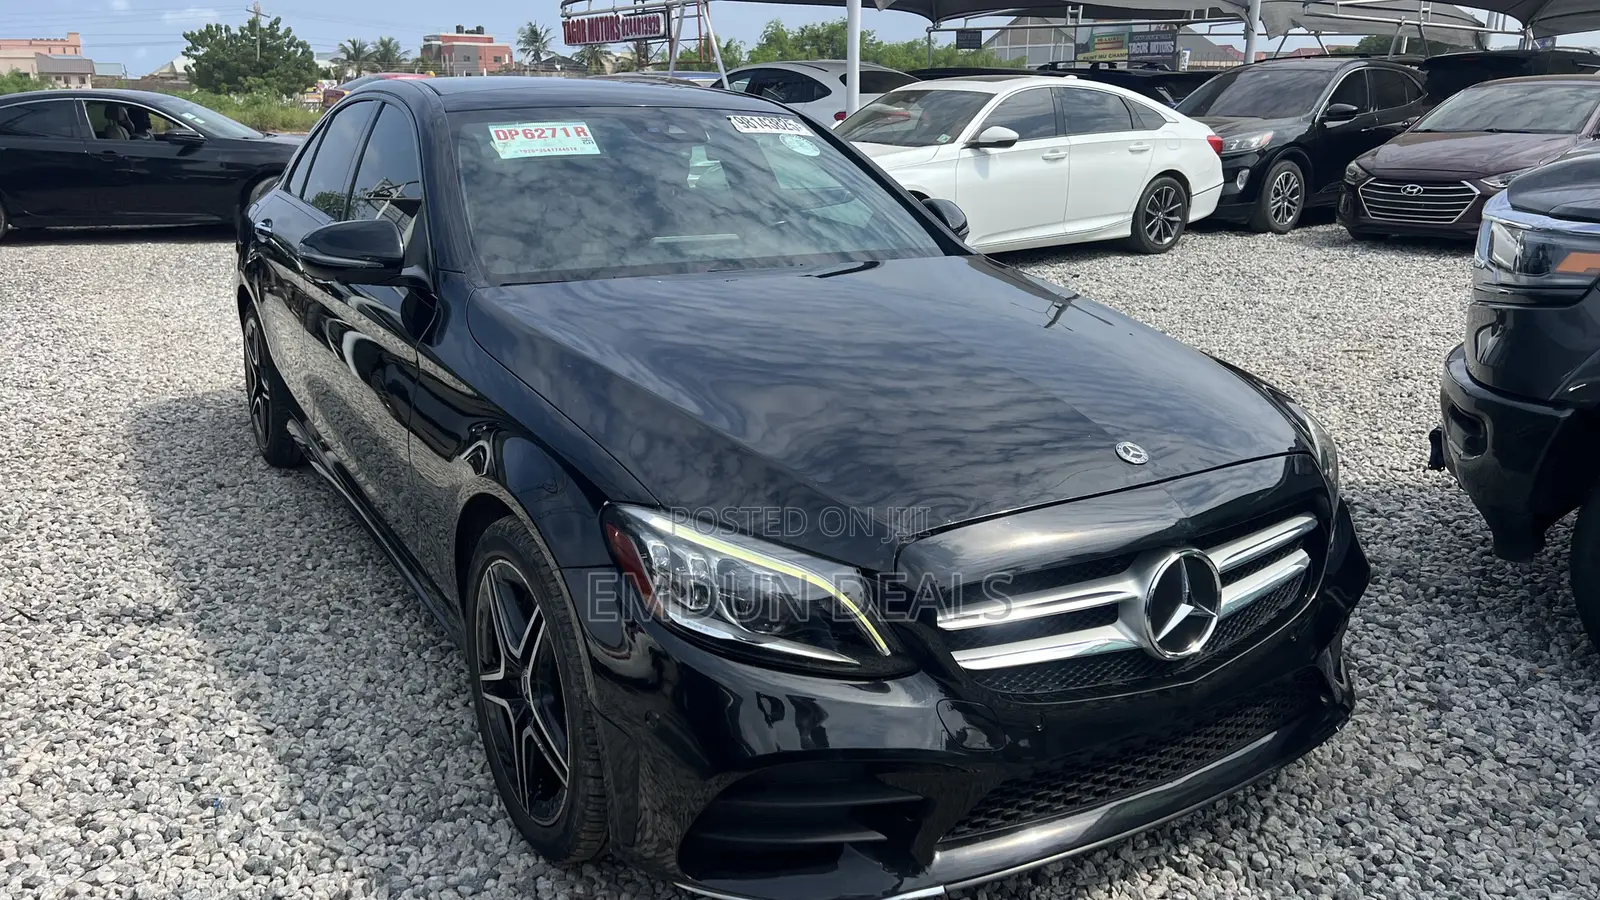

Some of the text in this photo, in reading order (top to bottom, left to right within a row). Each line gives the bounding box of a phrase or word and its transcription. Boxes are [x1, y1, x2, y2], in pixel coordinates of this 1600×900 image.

[562, 19, 587, 44] TAGOR
[587, 14, 621, 42] MOTORS
[1129, 41, 1174, 54] TAGOR MOTORS
[494, 126, 589, 141] DP 6271 R
